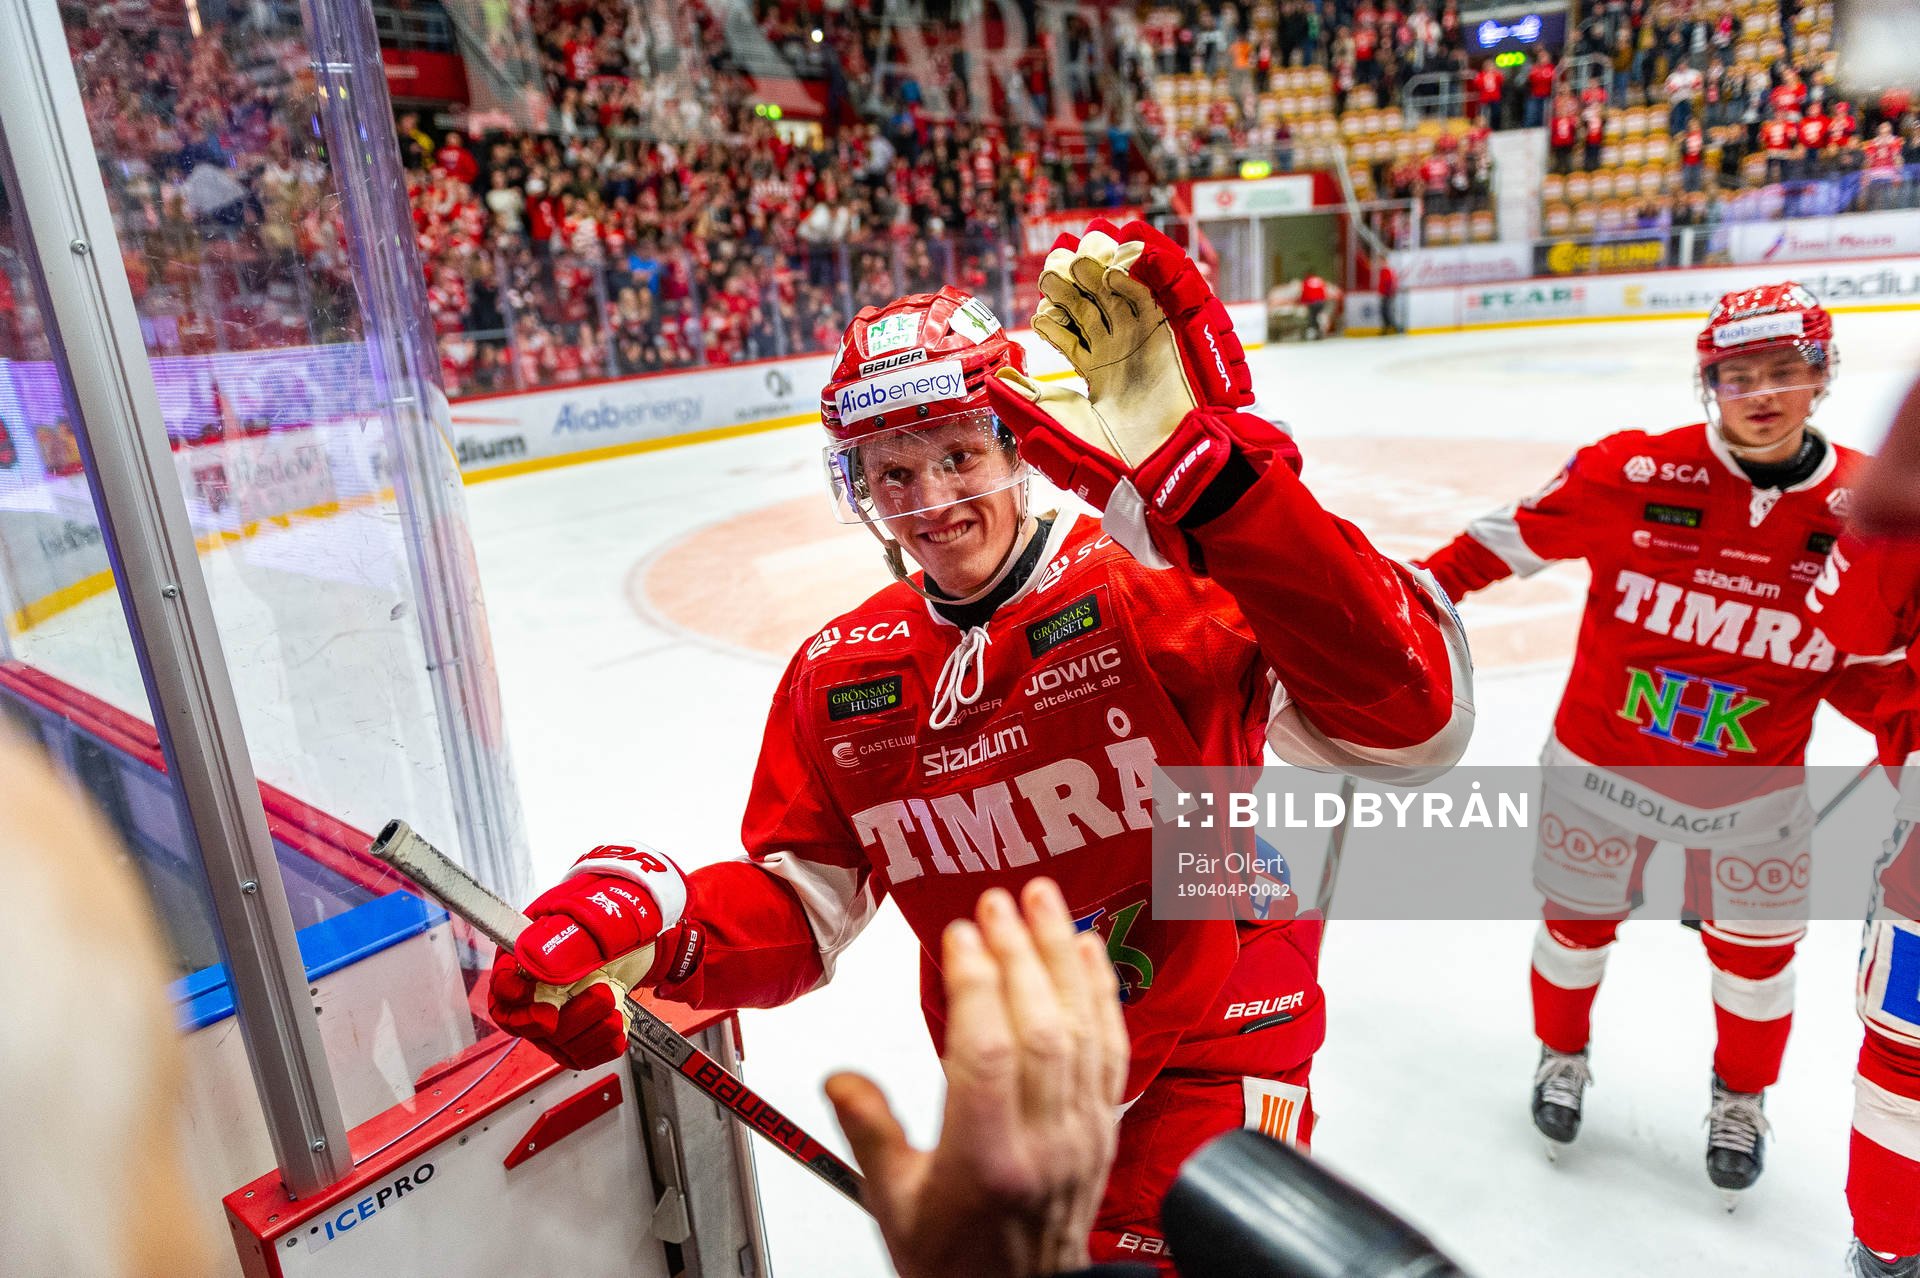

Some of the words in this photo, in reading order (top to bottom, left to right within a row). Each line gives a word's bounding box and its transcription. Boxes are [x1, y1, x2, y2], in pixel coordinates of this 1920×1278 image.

[1801, 268, 1920, 298] stadiu
[862, 350, 924, 376] BAUER
[1203, 323, 1232, 393] VAPOR
[840, 372, 962, 417] Aiabenergy
[458, 433, 527, 464] dium
[1155, 439, 1211, 508] BAUER
[1659, 462, 1711, 486] SCA
[1077, 533, 1114, 564] SC
[1692, 567, 1782, 600] stadium
[845, 620, 911, 644] SCA
[1033, 602, 1091, 641] GRÖNSAKS
[1049, 618, 1084, 645] HUSET
[1024, 647, 1122, 697] JOWIC
[832, 681, 895, 705] GRÖNSAKS
[850, 695, 889, 712] HUSET
[1034, 682, 1098, 711] elteknik
[1100, 674, 1121, 690] ab
[1616, 666, 1770, 757] NHK
[859, 735, 917, 756] CASTELLUM
[922, 724, 1029, 777] stadium
[851, 706, 1200, 885] TIMRÅ
[1584, 772, 1742, 833] BILBOLAGET
[677, 929, 698, 979] BAUER
[1224, 991, 1305, 1021] BAUER
[693, 1060, 798, 1146] BAUER
[324, 1162, 435, 1241] ICEPRO
